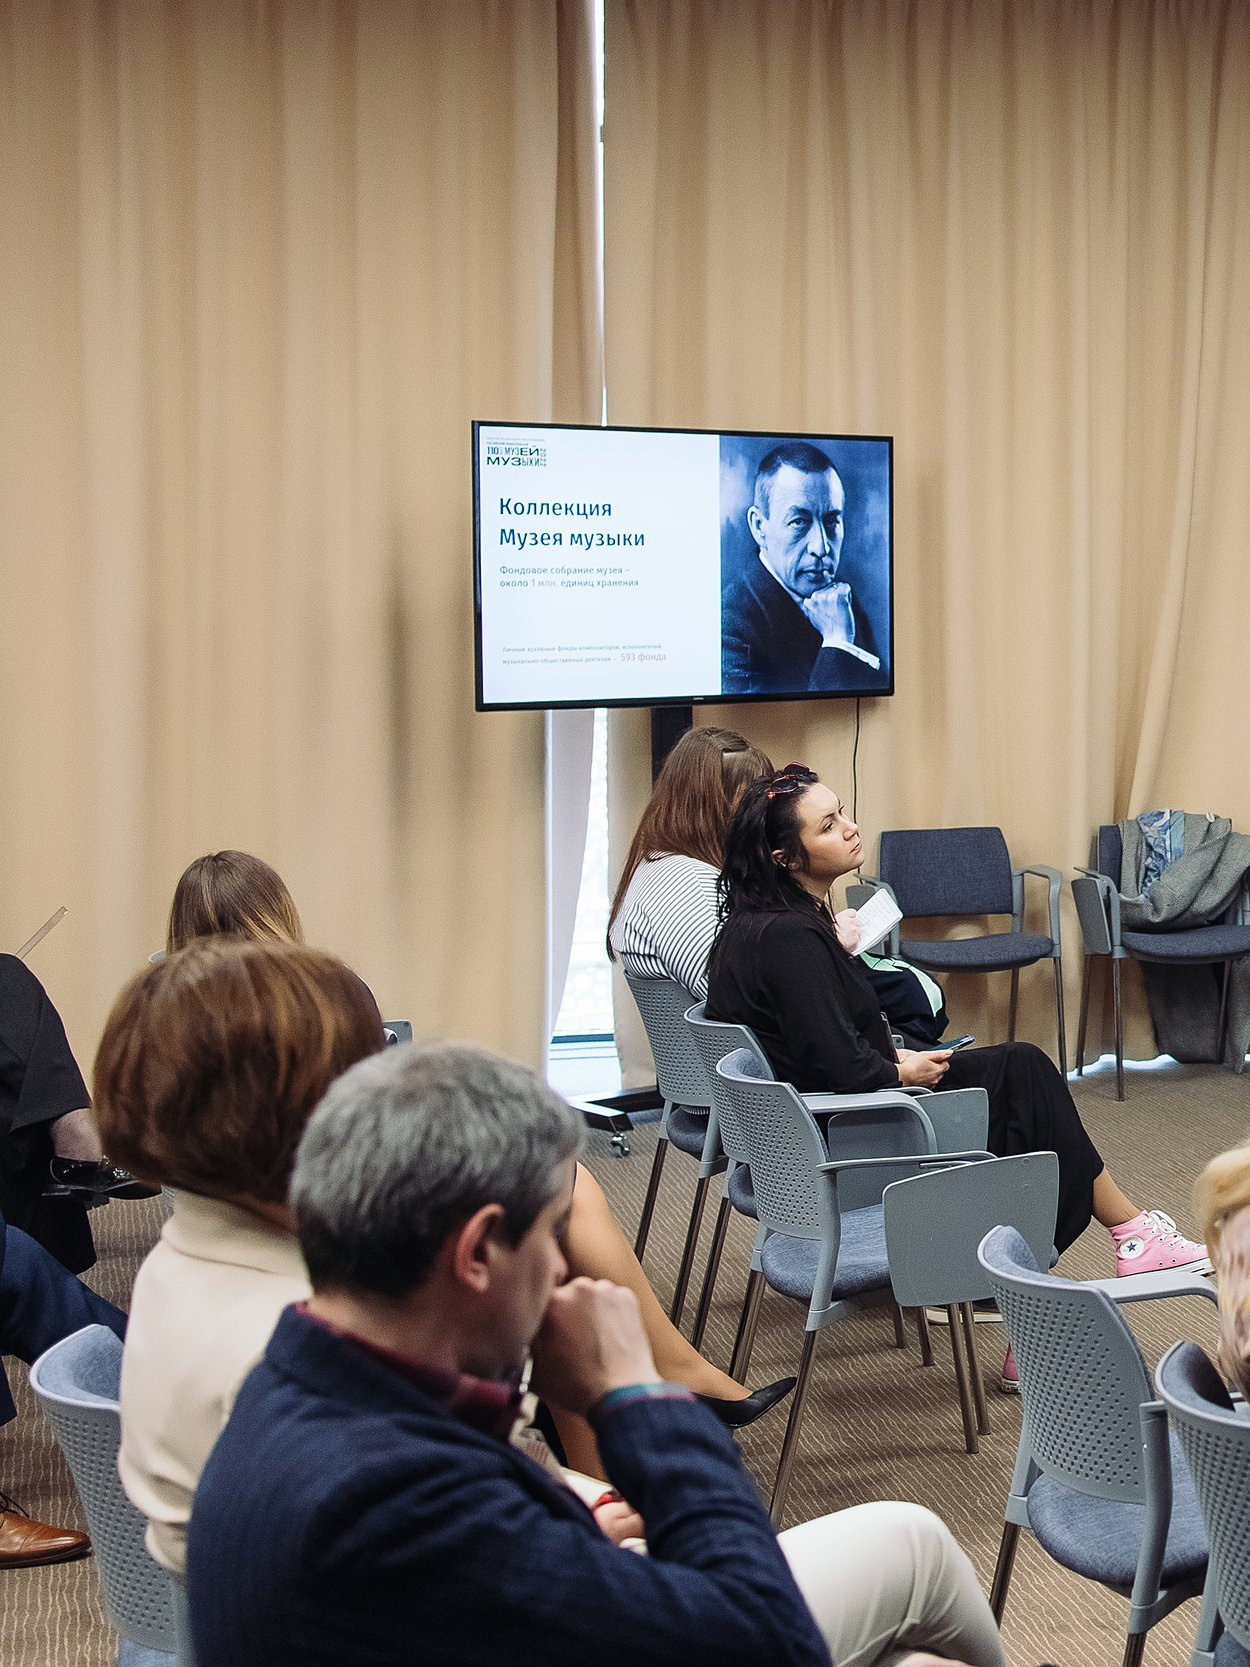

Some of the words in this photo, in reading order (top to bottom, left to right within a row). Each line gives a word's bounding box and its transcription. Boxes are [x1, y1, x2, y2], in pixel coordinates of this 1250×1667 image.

[504, 445, 540, 456] МУЗЕЙ
[486, 456, 540, 467] МУЗЫКИ
[499, 497, 612, 520] Коллекция
[499, 528, 563, 551] Музея
[570, 532, 645, 551] музыки
[499, 565, 548, 575] Фондовое
[550, 565, 594, 576] собрание
[596, 567, 623, 576] музея
[499, 580, 529, 588] около
[560, 579, 595, 589] единиц
[596, 579, 639, 589] хранения
[619, 652, 636, 662] 593
[637, 652, 667, 664] фонда
